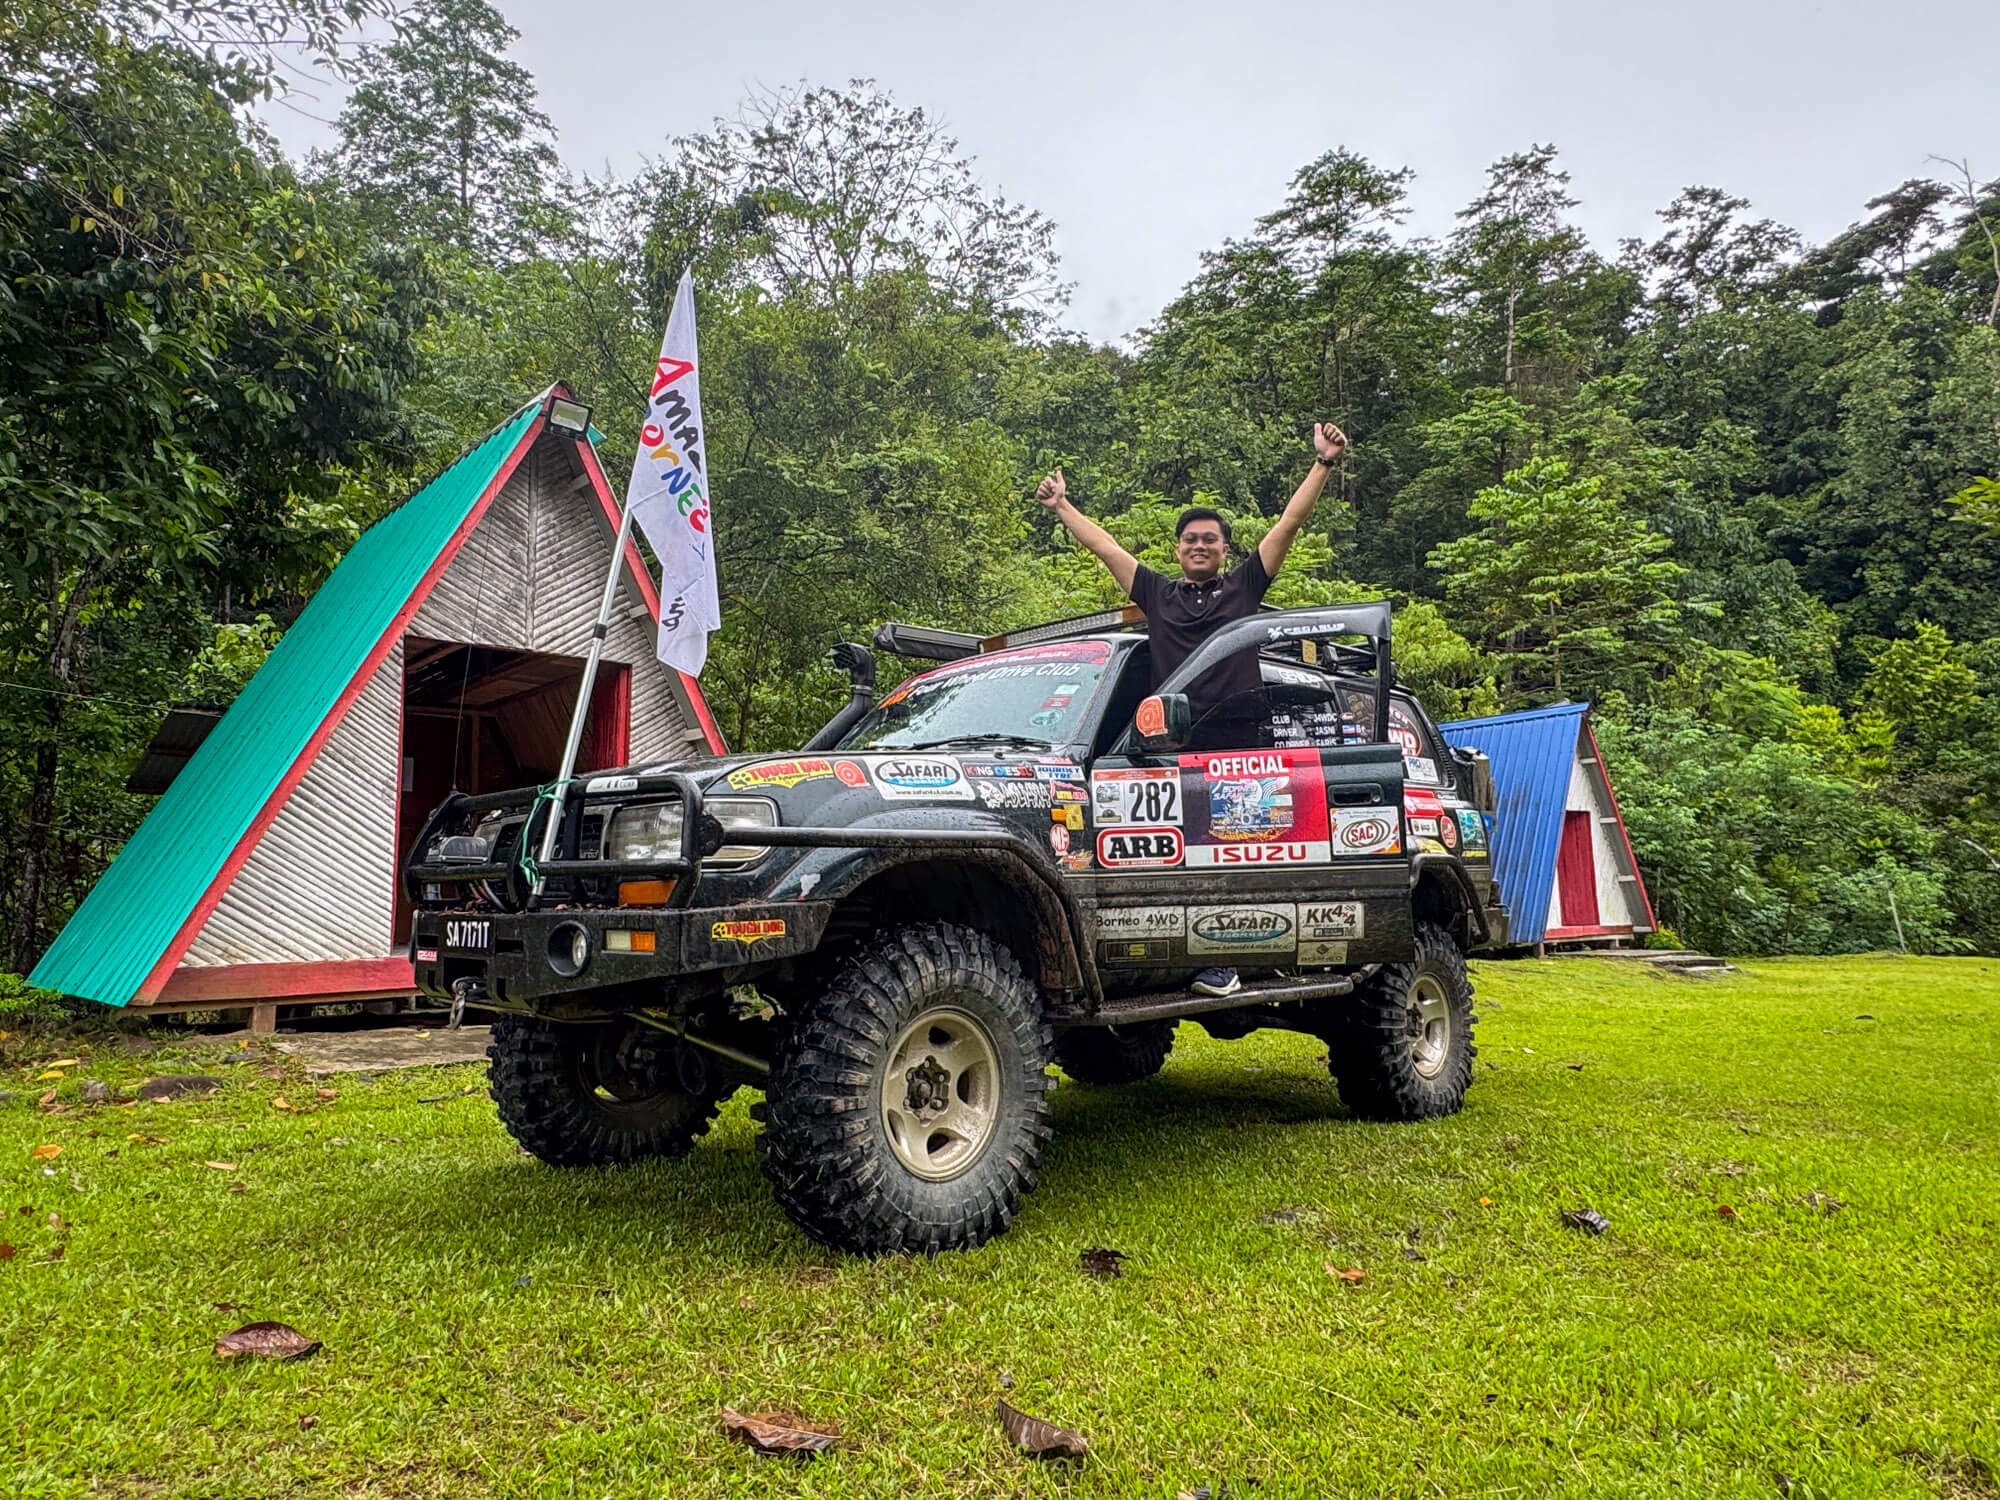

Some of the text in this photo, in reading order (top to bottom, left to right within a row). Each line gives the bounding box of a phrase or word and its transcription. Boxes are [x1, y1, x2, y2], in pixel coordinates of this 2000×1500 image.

[988, 665, 1034, 680] Drive
[1036, 663, 1081, 676] Club
[1272, 714, 1291, 724] CLUB
[1273, 727, 1297, 738] DRIVER
[746, 759, 830, 780] TOUGH DOG
[888, 762, 948, 778] SAFARI
[1208, 755, 1289, 777] OFFICIAL
[1128, 781, 1178, 823] 282
[1351, 825, 1374, 842] SAC
[1108, 835, 1177, 860] ARB
[1212, 844, 1306, 863] ISUZU
[725, 921, 784, 935] TOUGH DOG
[1096, 913, 1179, 927] Borneo 4WD
[1206, 913, 1278, 931] SAFARI
